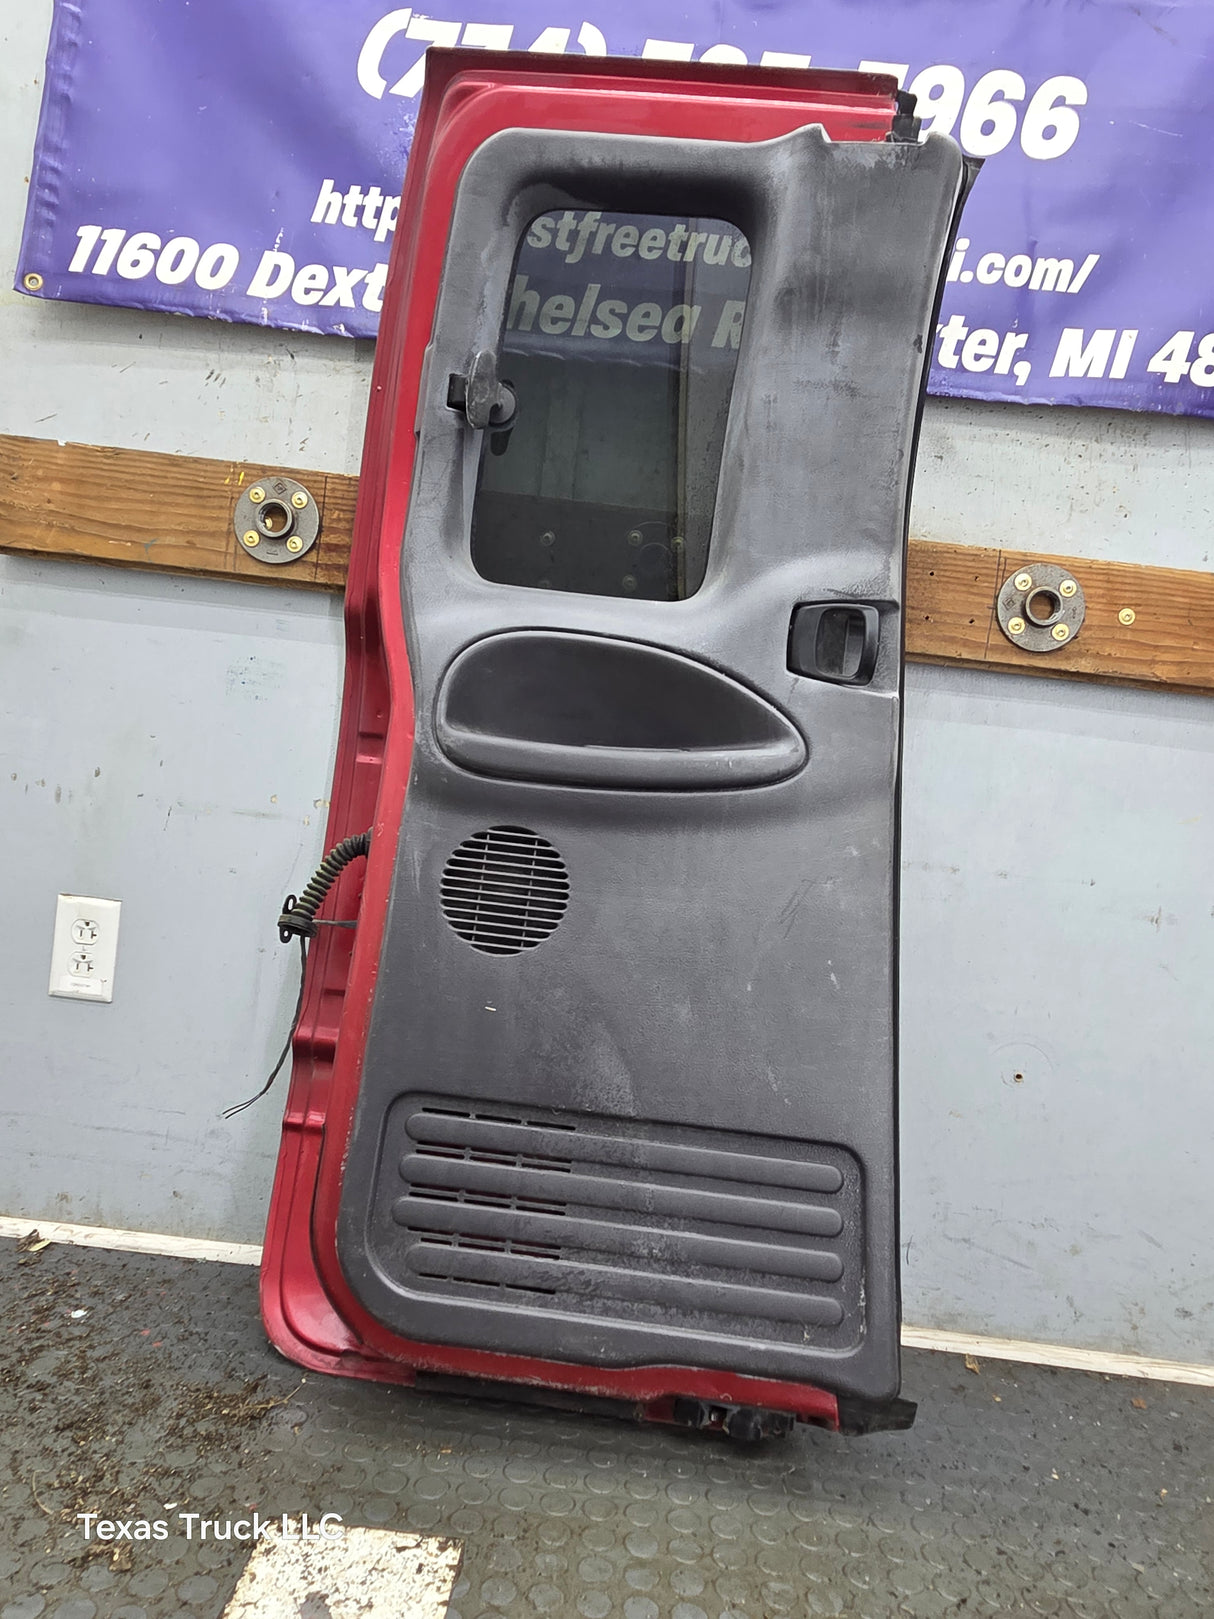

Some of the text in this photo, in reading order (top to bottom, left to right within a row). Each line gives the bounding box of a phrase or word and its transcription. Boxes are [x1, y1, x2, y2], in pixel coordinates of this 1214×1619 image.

[68, 224, 240, 291] 11600
[935, 314, 1032, 386] ter,
[1049, 327, 1139, 379] MI
[947, 237, 1100, 294] i.com/
